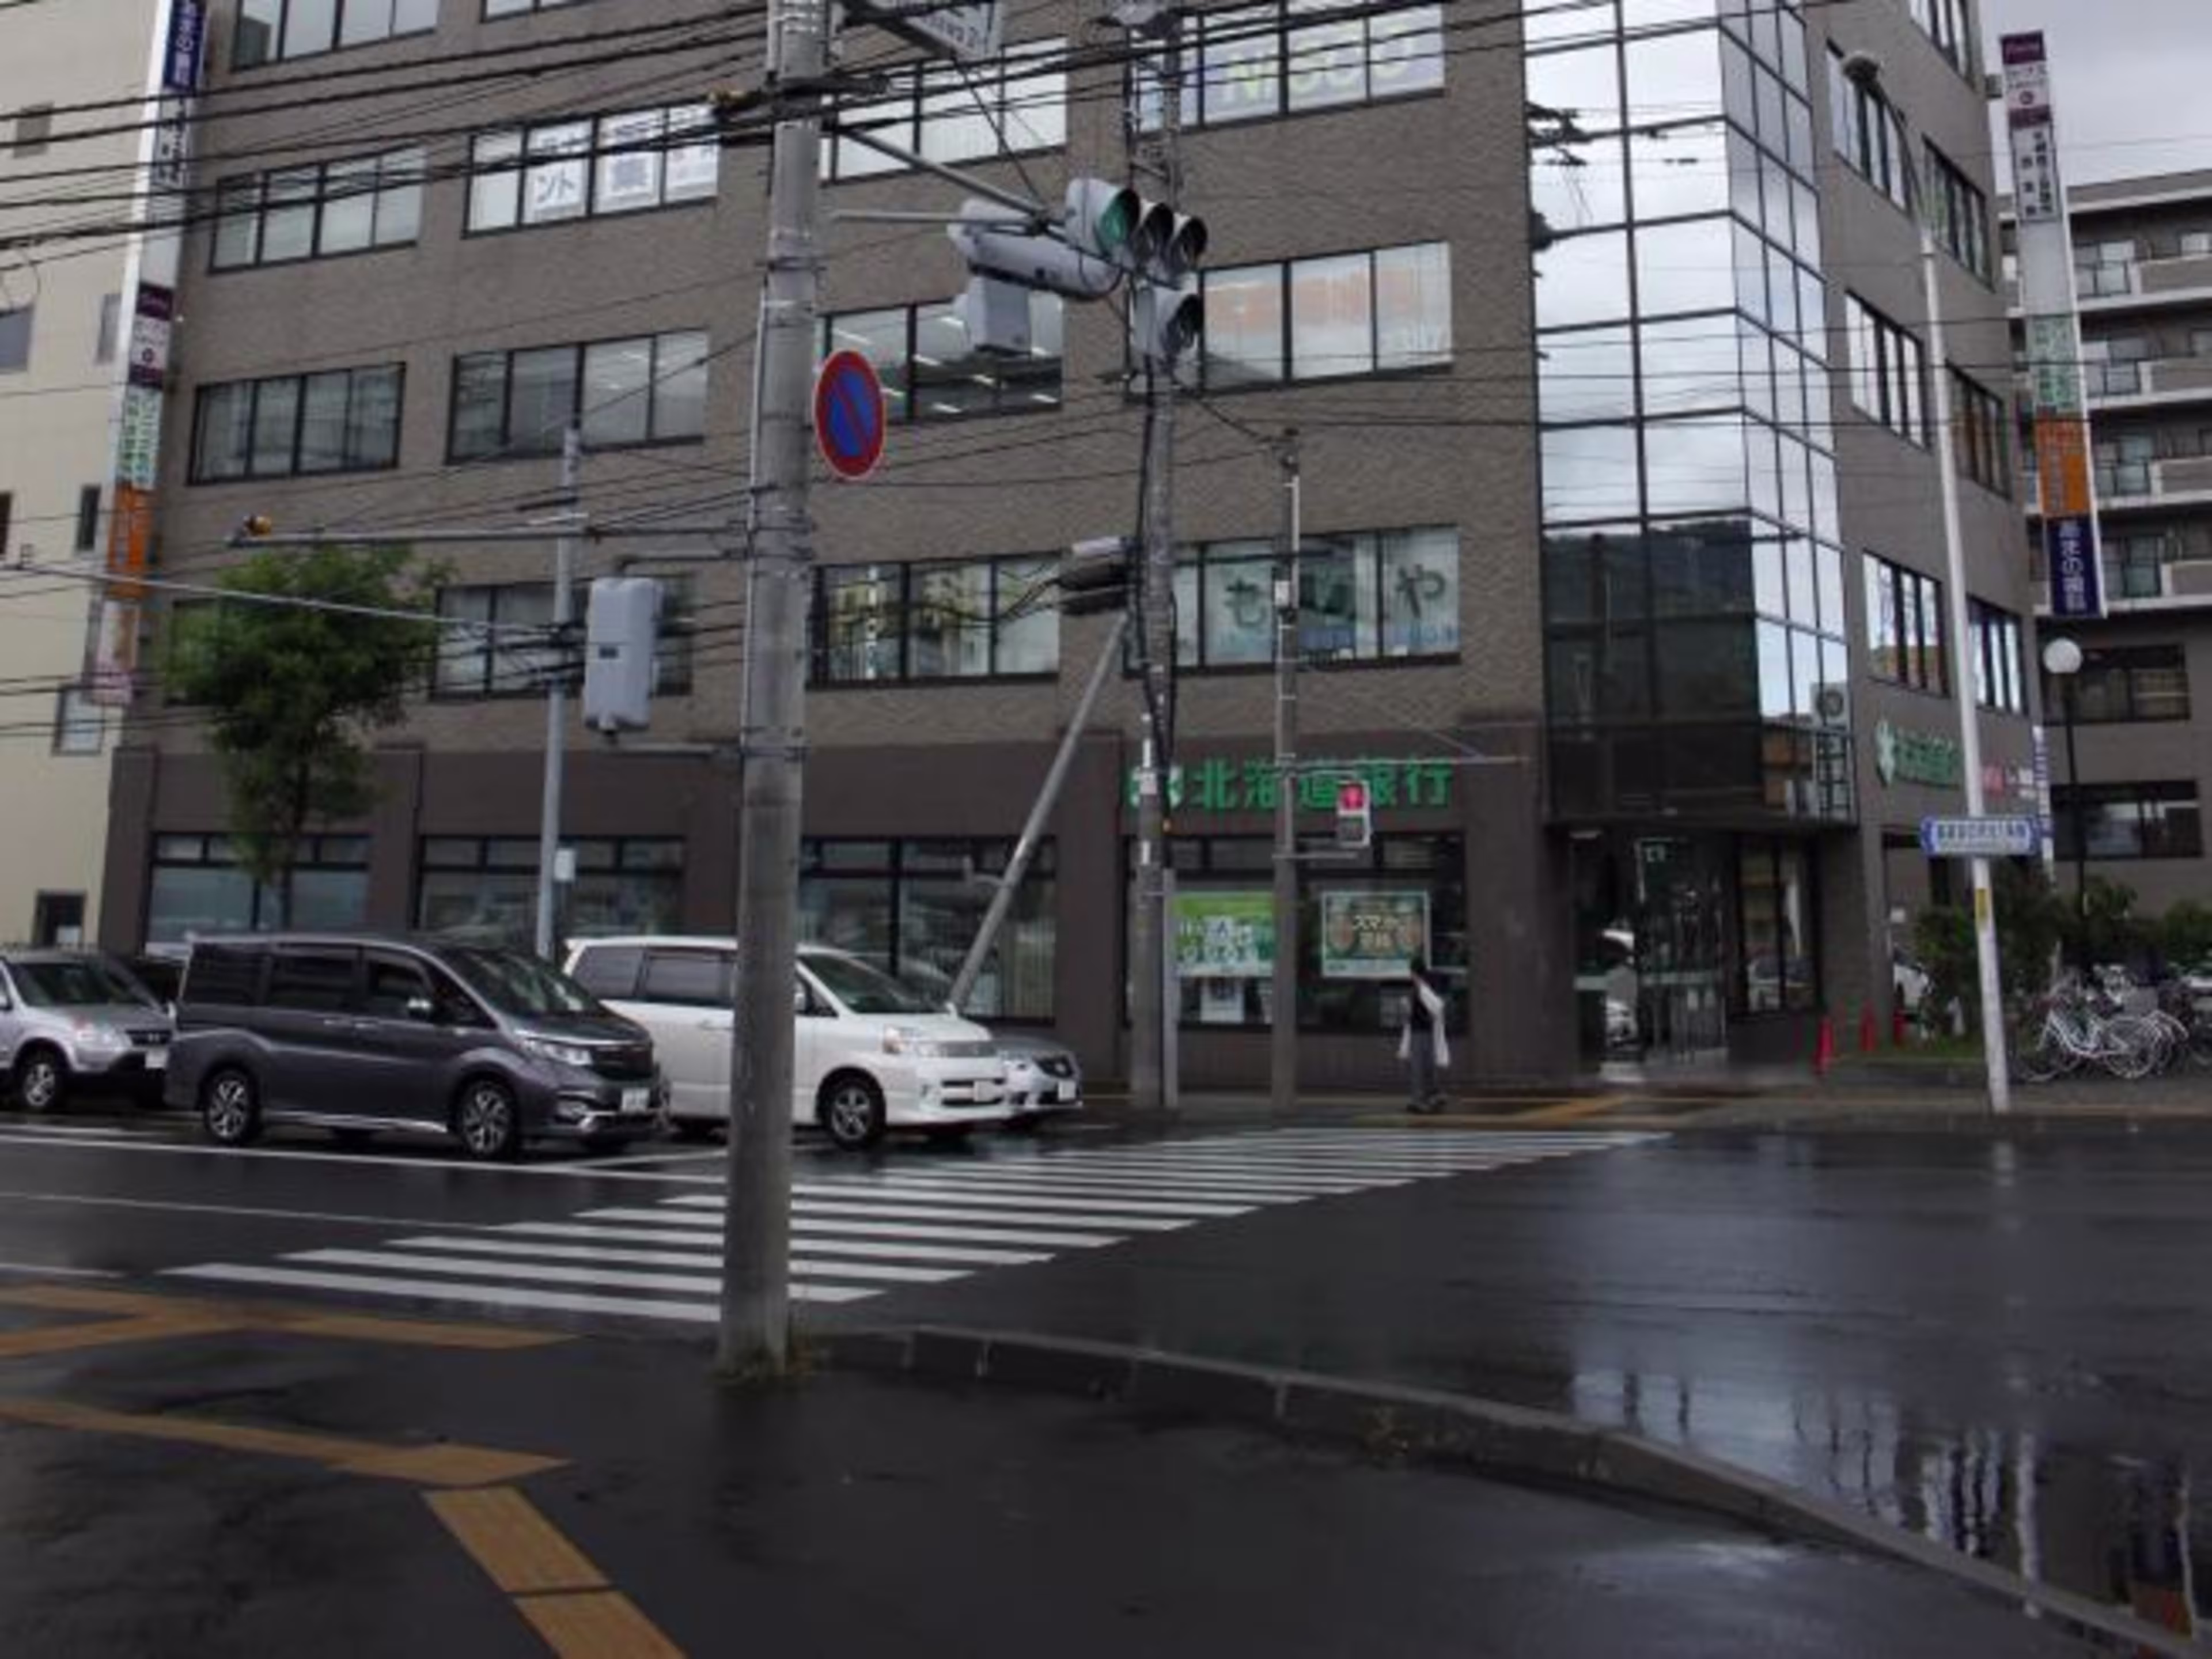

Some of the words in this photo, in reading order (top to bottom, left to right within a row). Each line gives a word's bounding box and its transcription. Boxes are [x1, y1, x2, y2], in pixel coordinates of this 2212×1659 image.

[1194, 756, 1452, 808] 北海道銀行
